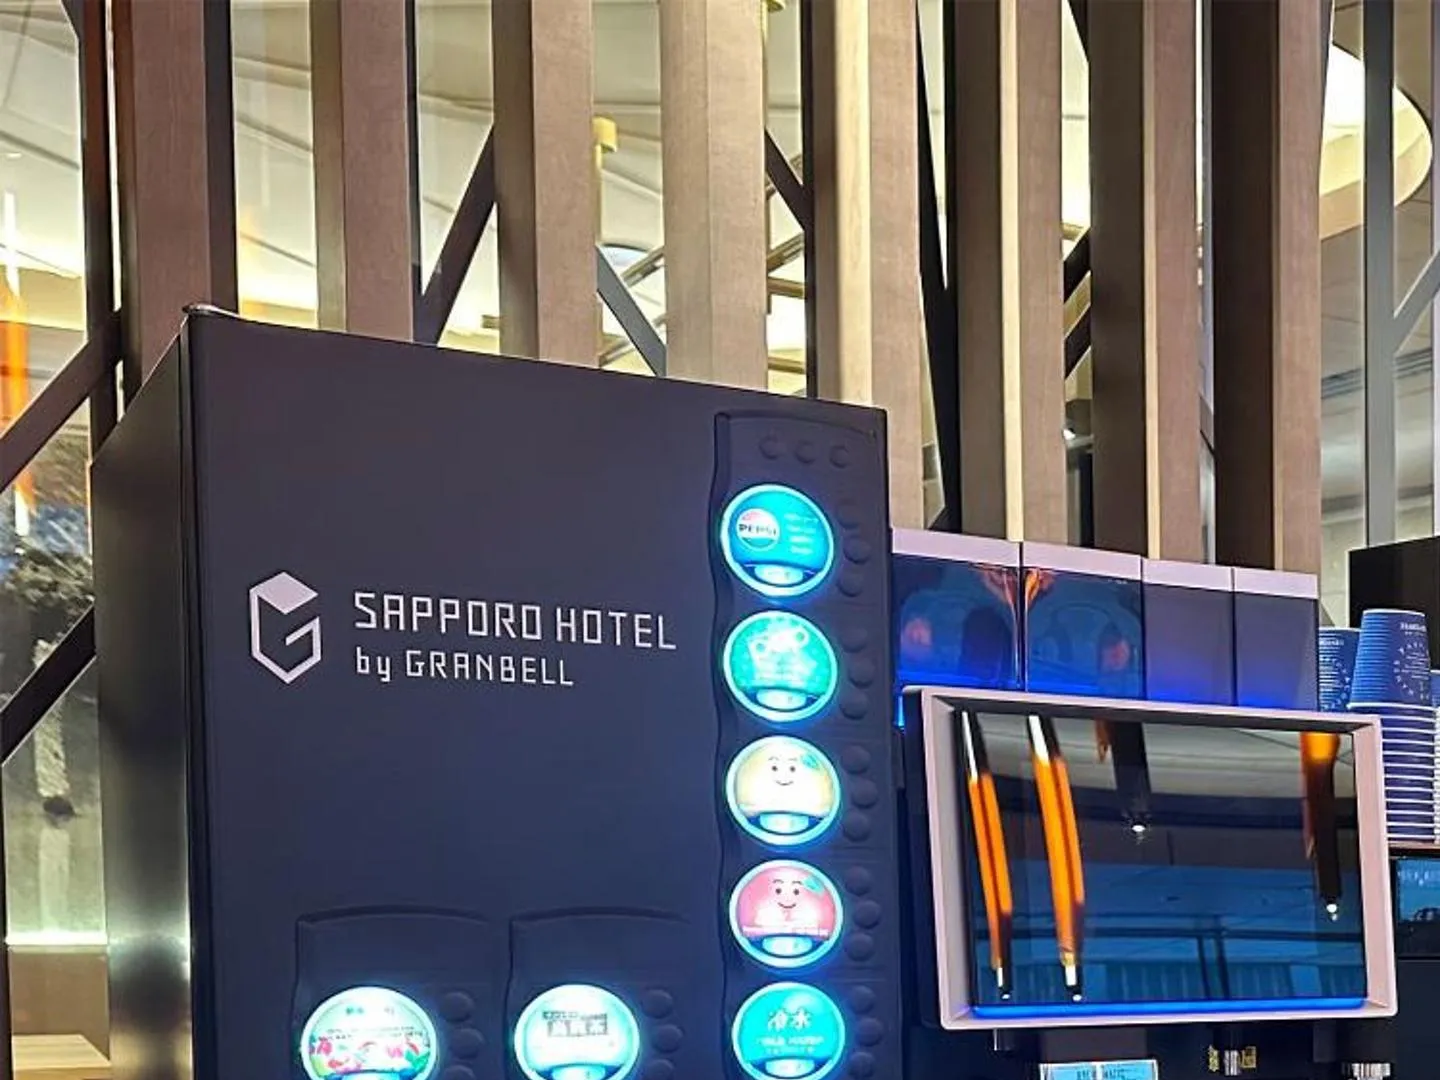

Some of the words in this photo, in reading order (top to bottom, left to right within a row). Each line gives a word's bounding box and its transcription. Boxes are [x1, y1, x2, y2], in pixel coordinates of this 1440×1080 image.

[354, 591, 542, 640] SAPPORO
[556, 606, 677, 650] HOTEL
[356, 646, 391, 683] by
[406, 649, 574, 686] GRANBELL
